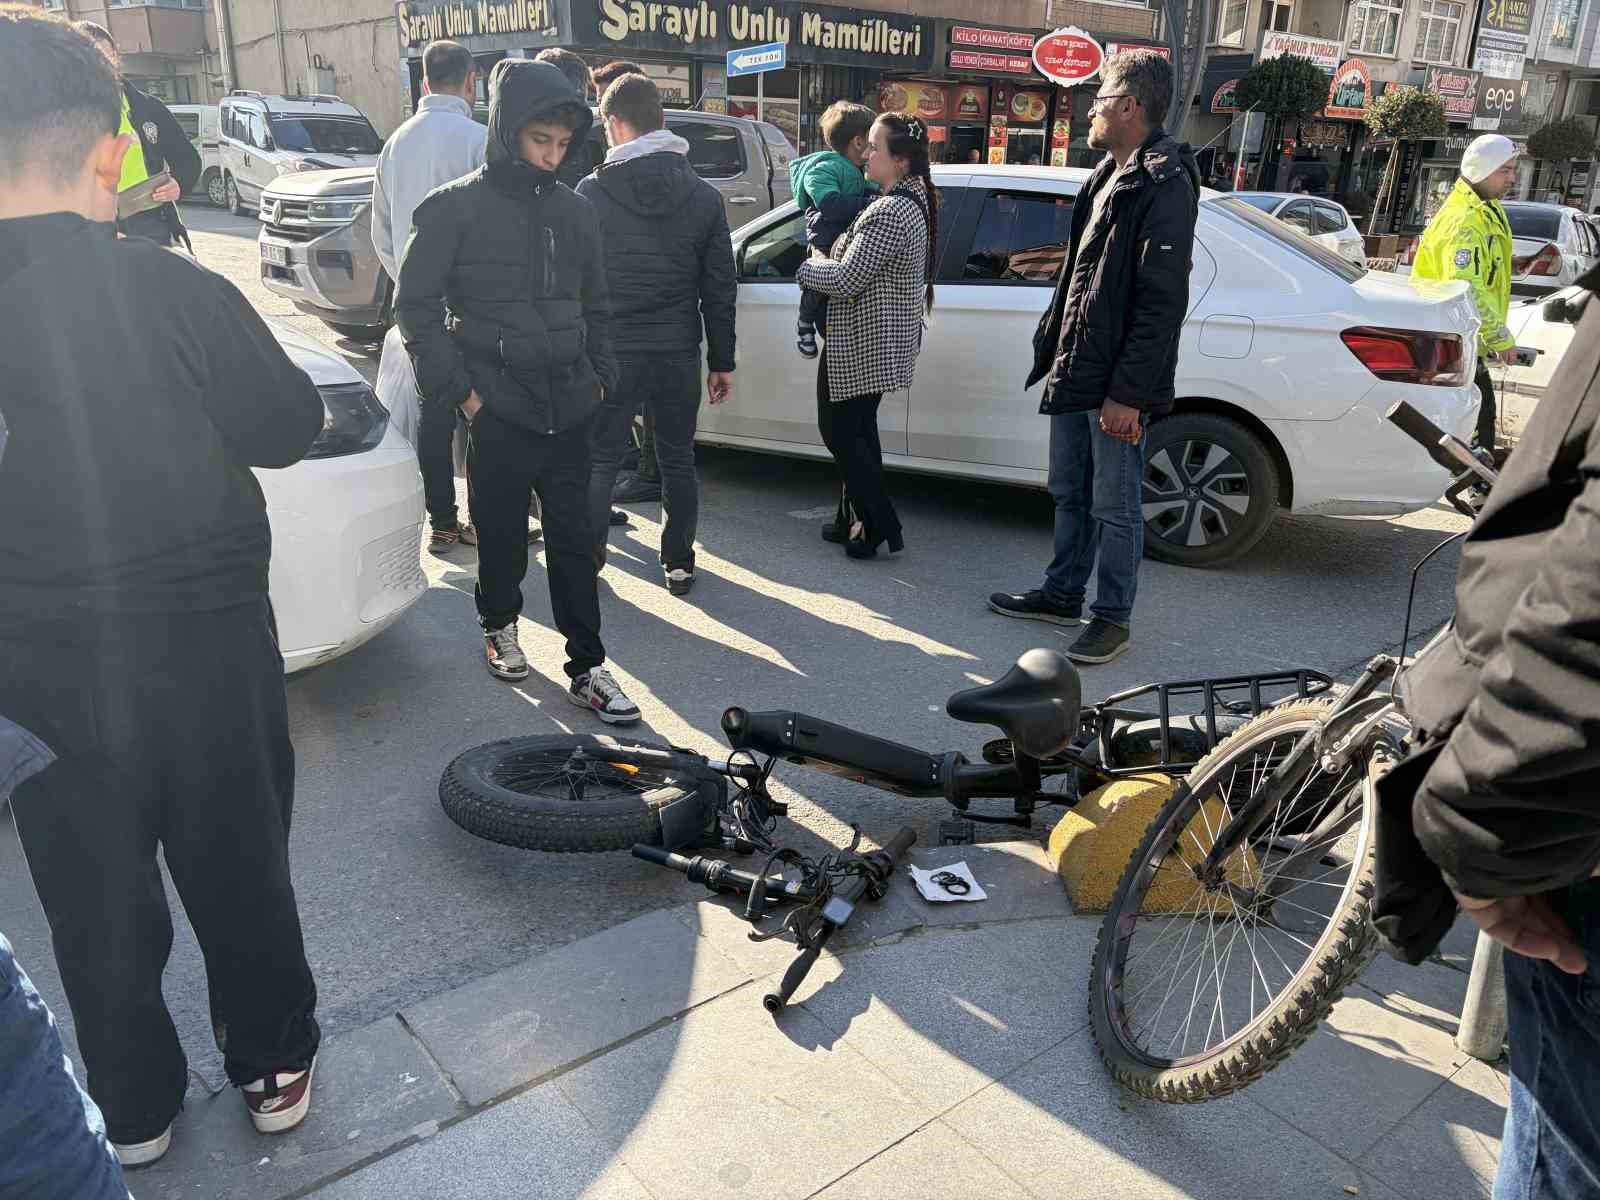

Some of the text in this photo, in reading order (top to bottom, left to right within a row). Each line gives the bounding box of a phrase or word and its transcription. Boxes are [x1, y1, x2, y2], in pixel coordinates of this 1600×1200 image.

[445, 1, 473, 36] Unlu
[601, 0, 921, 56] Saraylı Unlu Mamülleri
[956, 29, 1033, 47] KİLO KANAT KÖFTE
[1274, 37, 1339, 57] YAĞMUR TURİZM
[1485, 87, 1514, 118] ege
